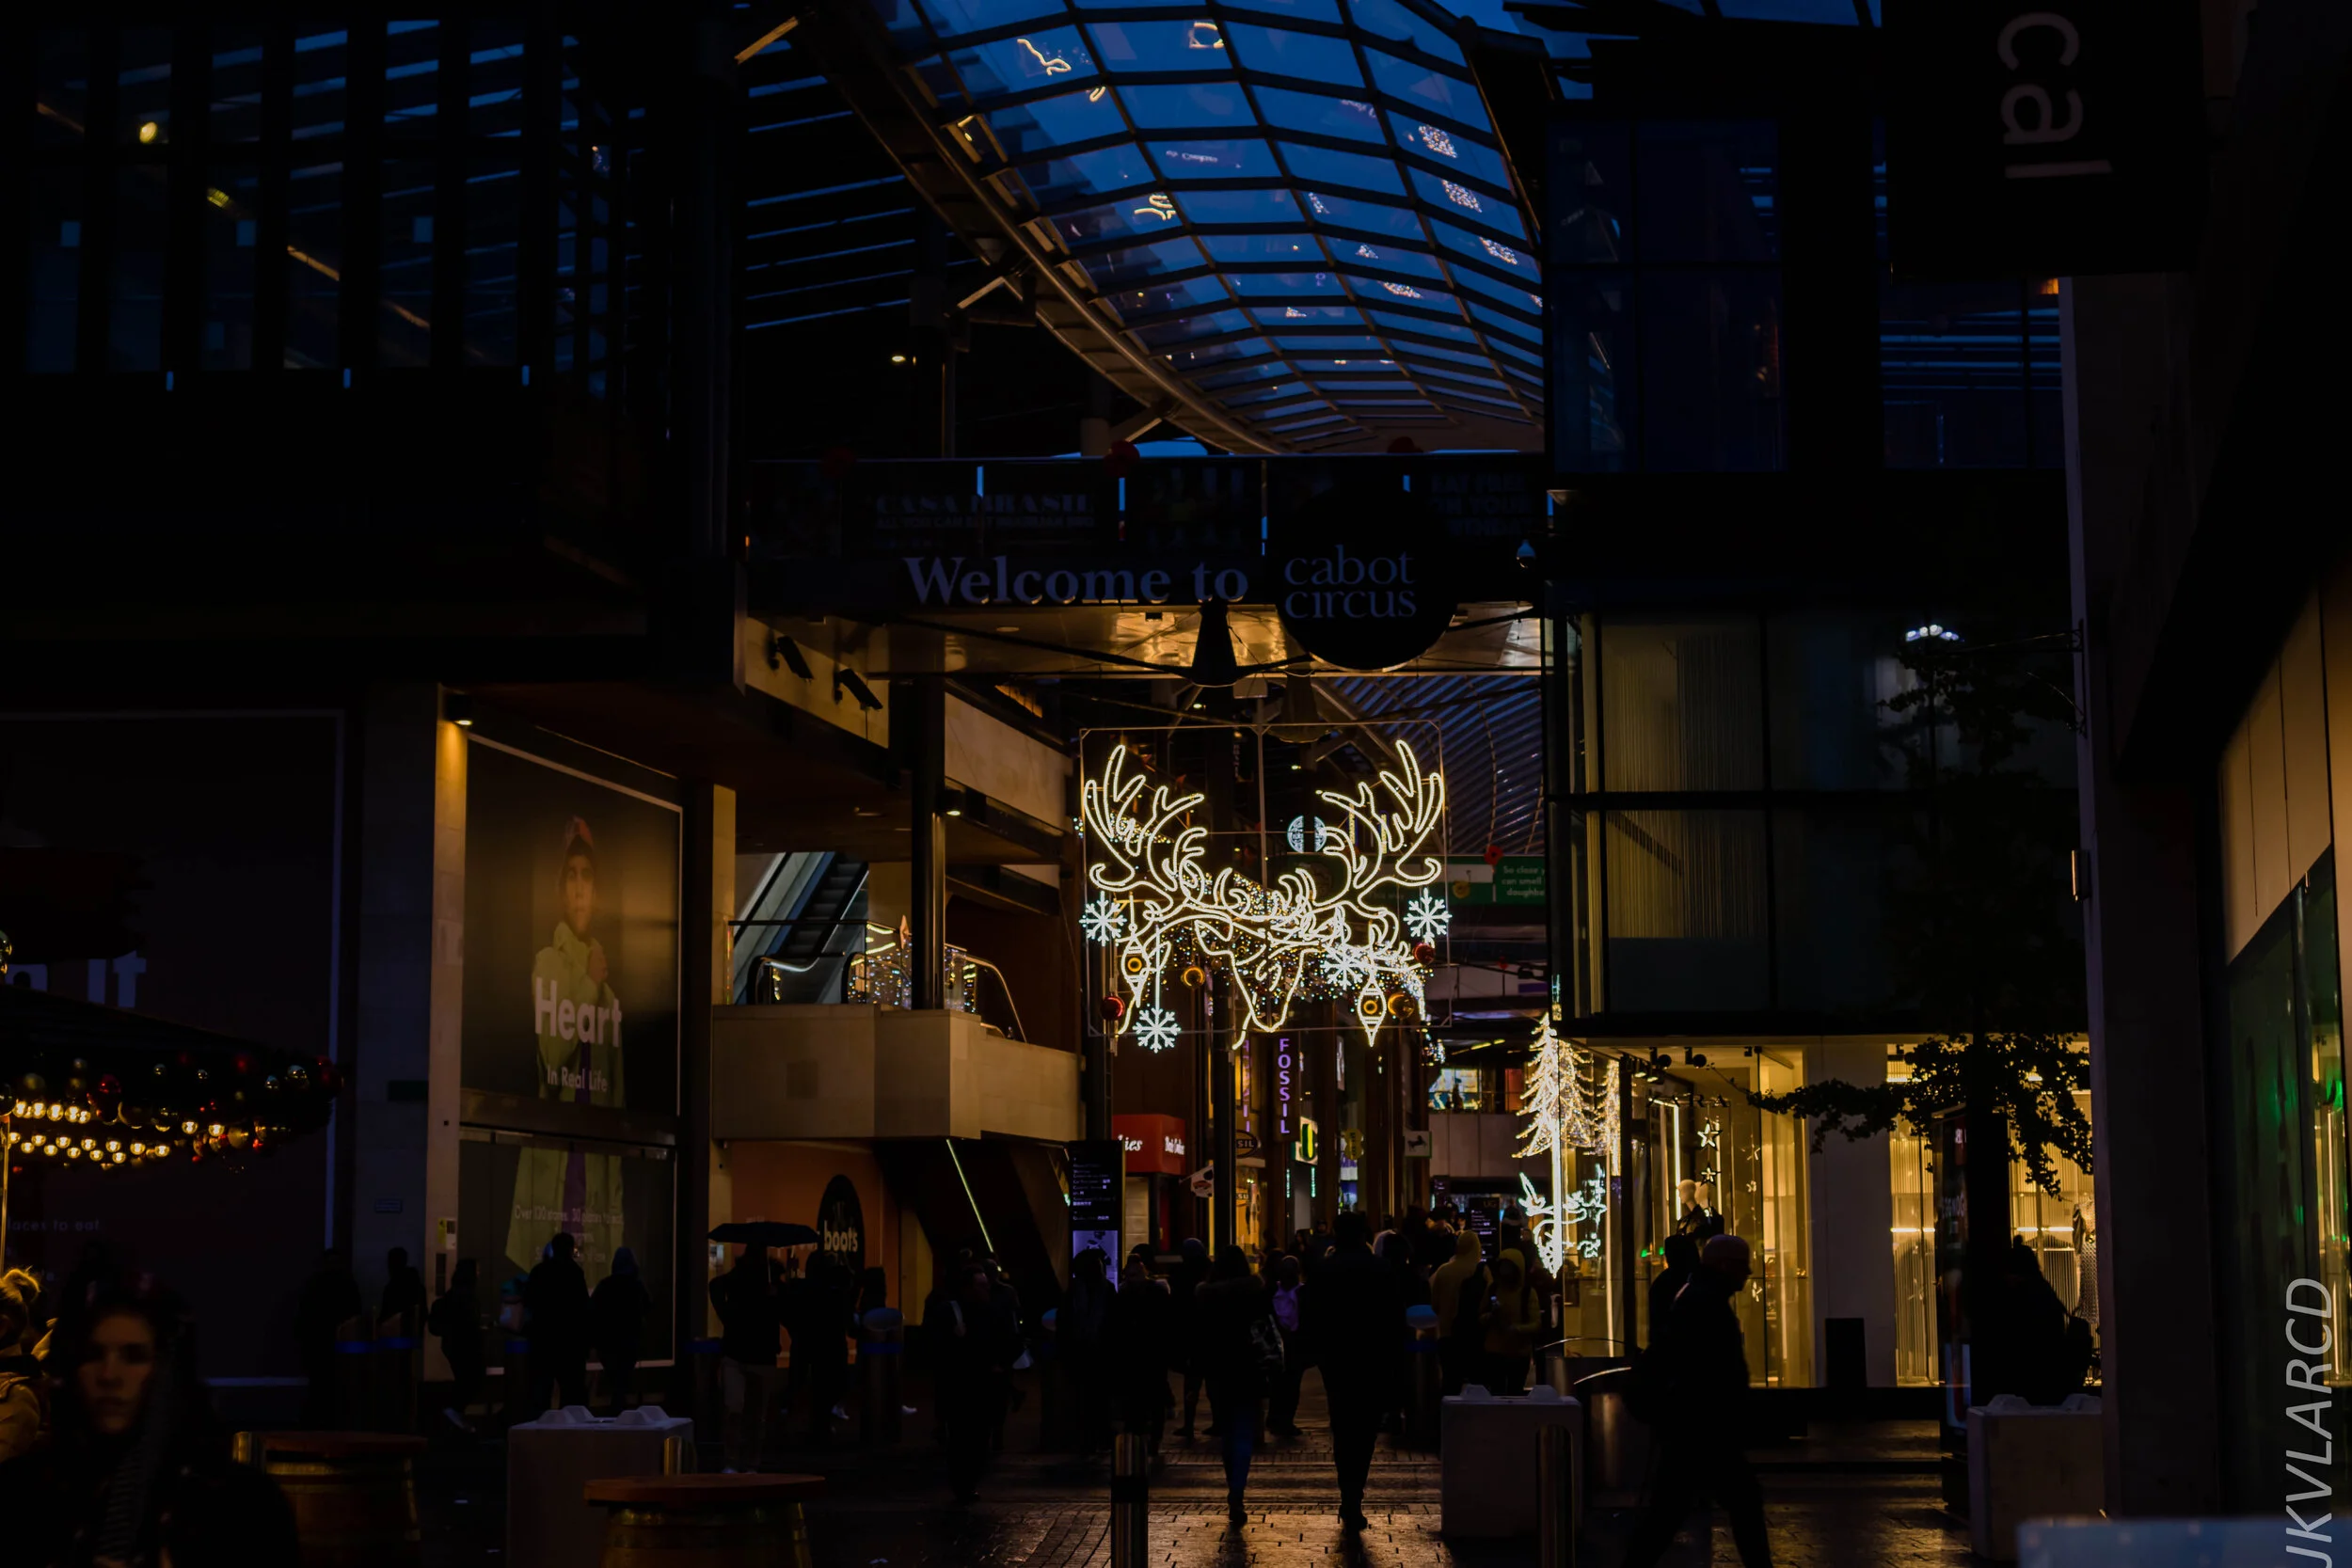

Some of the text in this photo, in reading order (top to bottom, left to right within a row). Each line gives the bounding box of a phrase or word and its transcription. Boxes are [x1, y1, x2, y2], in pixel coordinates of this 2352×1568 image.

[1996, 10, 2113, 180] cal
[900, 554, 1249, 606] Welcome to
[1283, 542, 1418, 586] cabot
[1283, 590, 1420, 620] circus
[534, 976, 623, 1048] Heart
[547, 1064, 609, 1093] In Real Life
[1278, 1037, 1292, 1134] FOSSIL
[1237, 1139, 1255, 1148] SIL
[823, 1219, 858, 1253] boots
